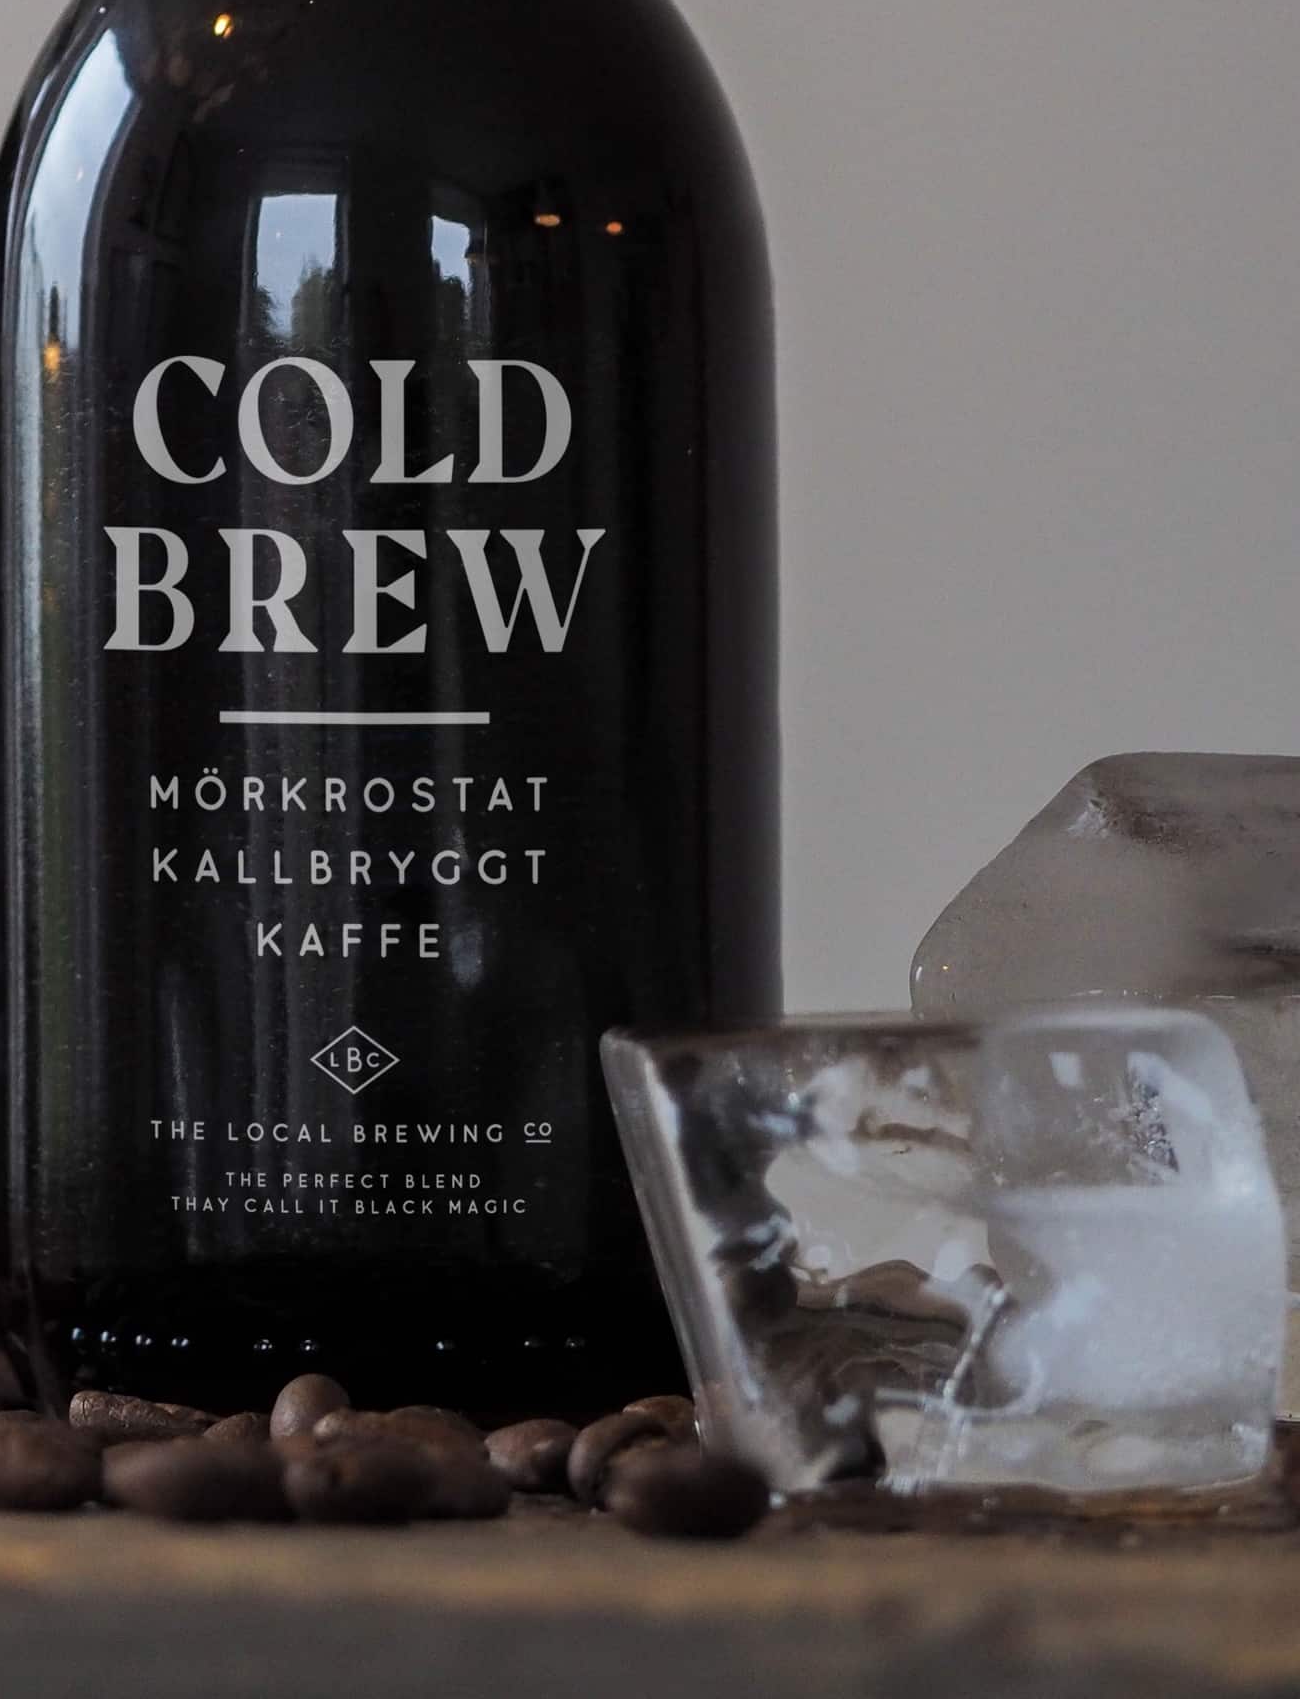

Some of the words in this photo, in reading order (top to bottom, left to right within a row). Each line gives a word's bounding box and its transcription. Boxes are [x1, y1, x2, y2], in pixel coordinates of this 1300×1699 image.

[133, 355, 572, 485] COLD
[103, 526, 606, 653] BREW
[150, 767, 548, 813] MÖRKROSTAT
[152, 848, 546, 885] KALLBRYGGT
[257, 922, 440, 958] KAFFE
[150, 1120, 206, 1141] THE
[228, 1122, 332, 1143] LOCAL
[354, 1123, 504, 1144] BREWING
[523, 1121, 553, 1138] CO
[226, 1171, 268, 1189] THE
[283, 1173, 390, 1190] PERFECT
[405, 1173, 482, 1190] BLEND
[171, 1196, 229, 1213] THAY
[244, 1198, 305, 1214] CALL
[318, 1198, 340, 1215] IT
[354, 1199, 434, 1216] BLACK
[448, 1198, 527, 1215] MAGIC
